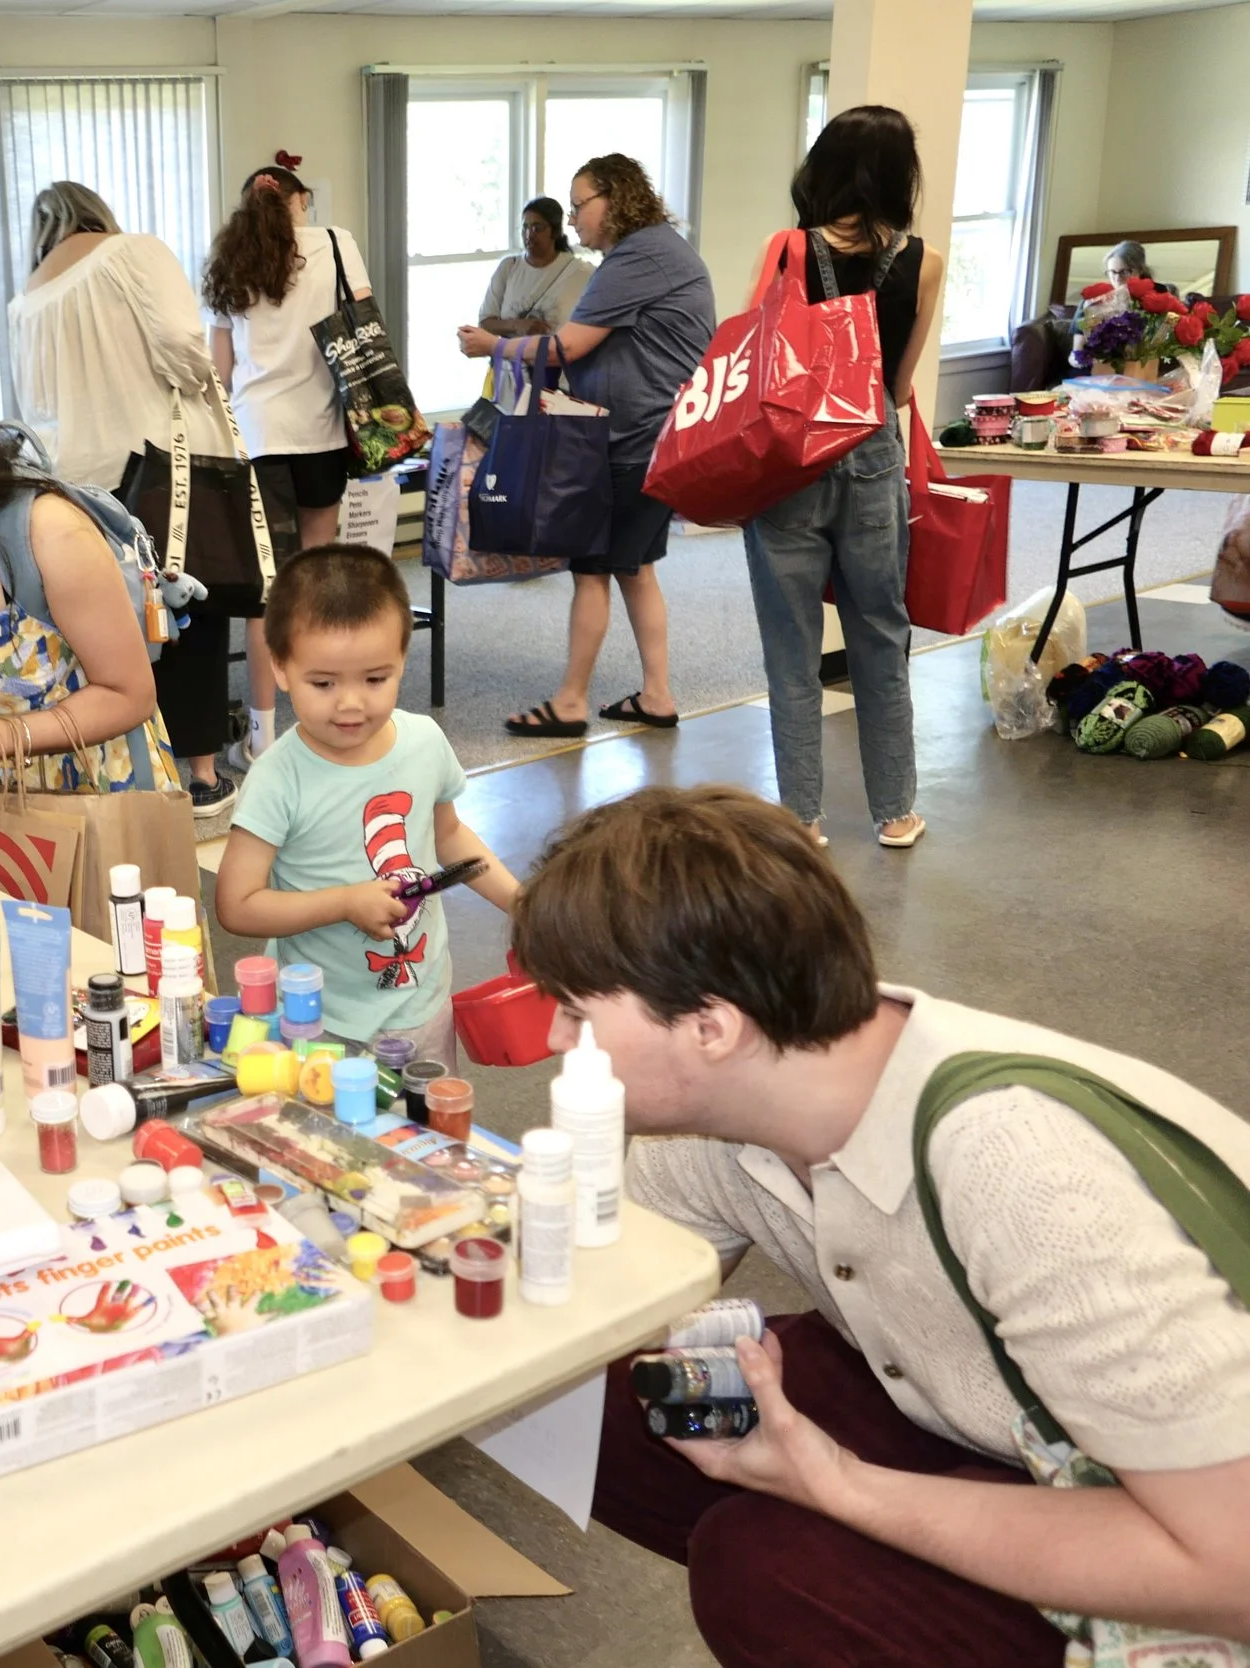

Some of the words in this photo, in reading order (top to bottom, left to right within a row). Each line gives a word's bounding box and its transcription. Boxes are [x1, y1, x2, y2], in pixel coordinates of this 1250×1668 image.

[174, 432, 188, 471] 1976
[174, 477, 187, 509] EST.
[348, 489, 368, 498] Pencils
[36, 1250, 126, 1286] finger
[132, 1224, 223, 1262] paints
